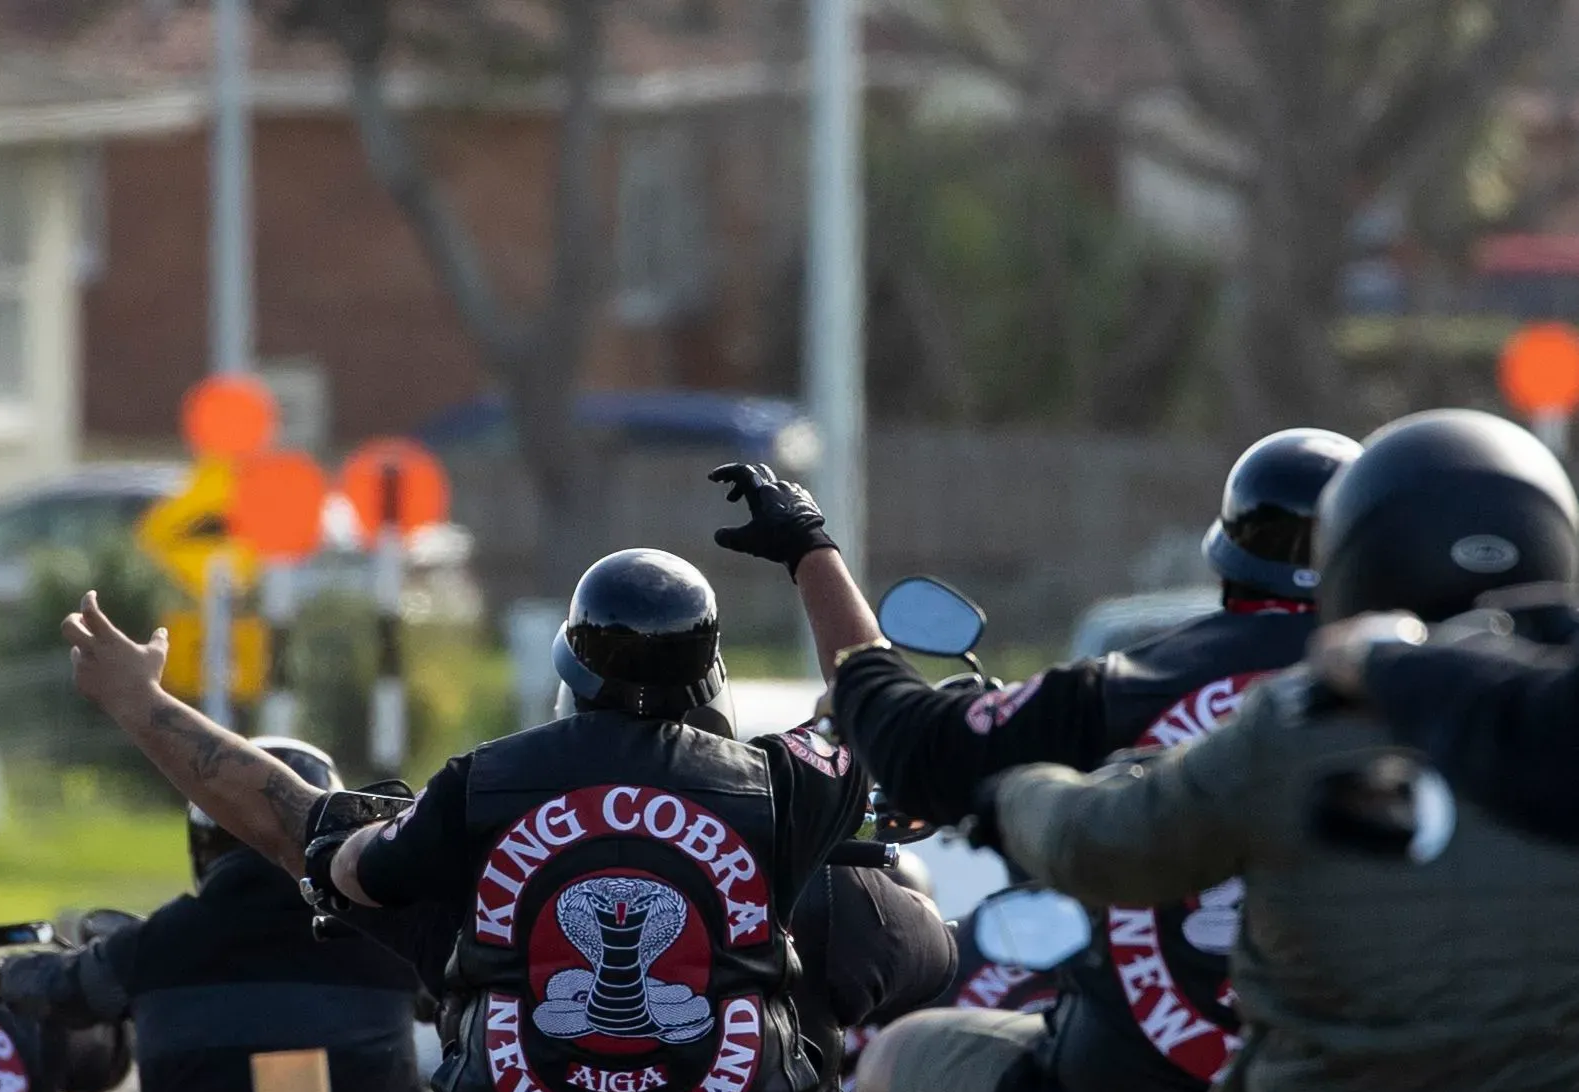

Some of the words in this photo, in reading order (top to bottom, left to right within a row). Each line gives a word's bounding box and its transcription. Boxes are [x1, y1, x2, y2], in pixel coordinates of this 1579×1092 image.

[1148, 678, 1245, 746] NG
[476, 796, 587, 943] KING
[602, 786, 768, 943] COBRA
[1109, 905, 1217, 1056] NEW
